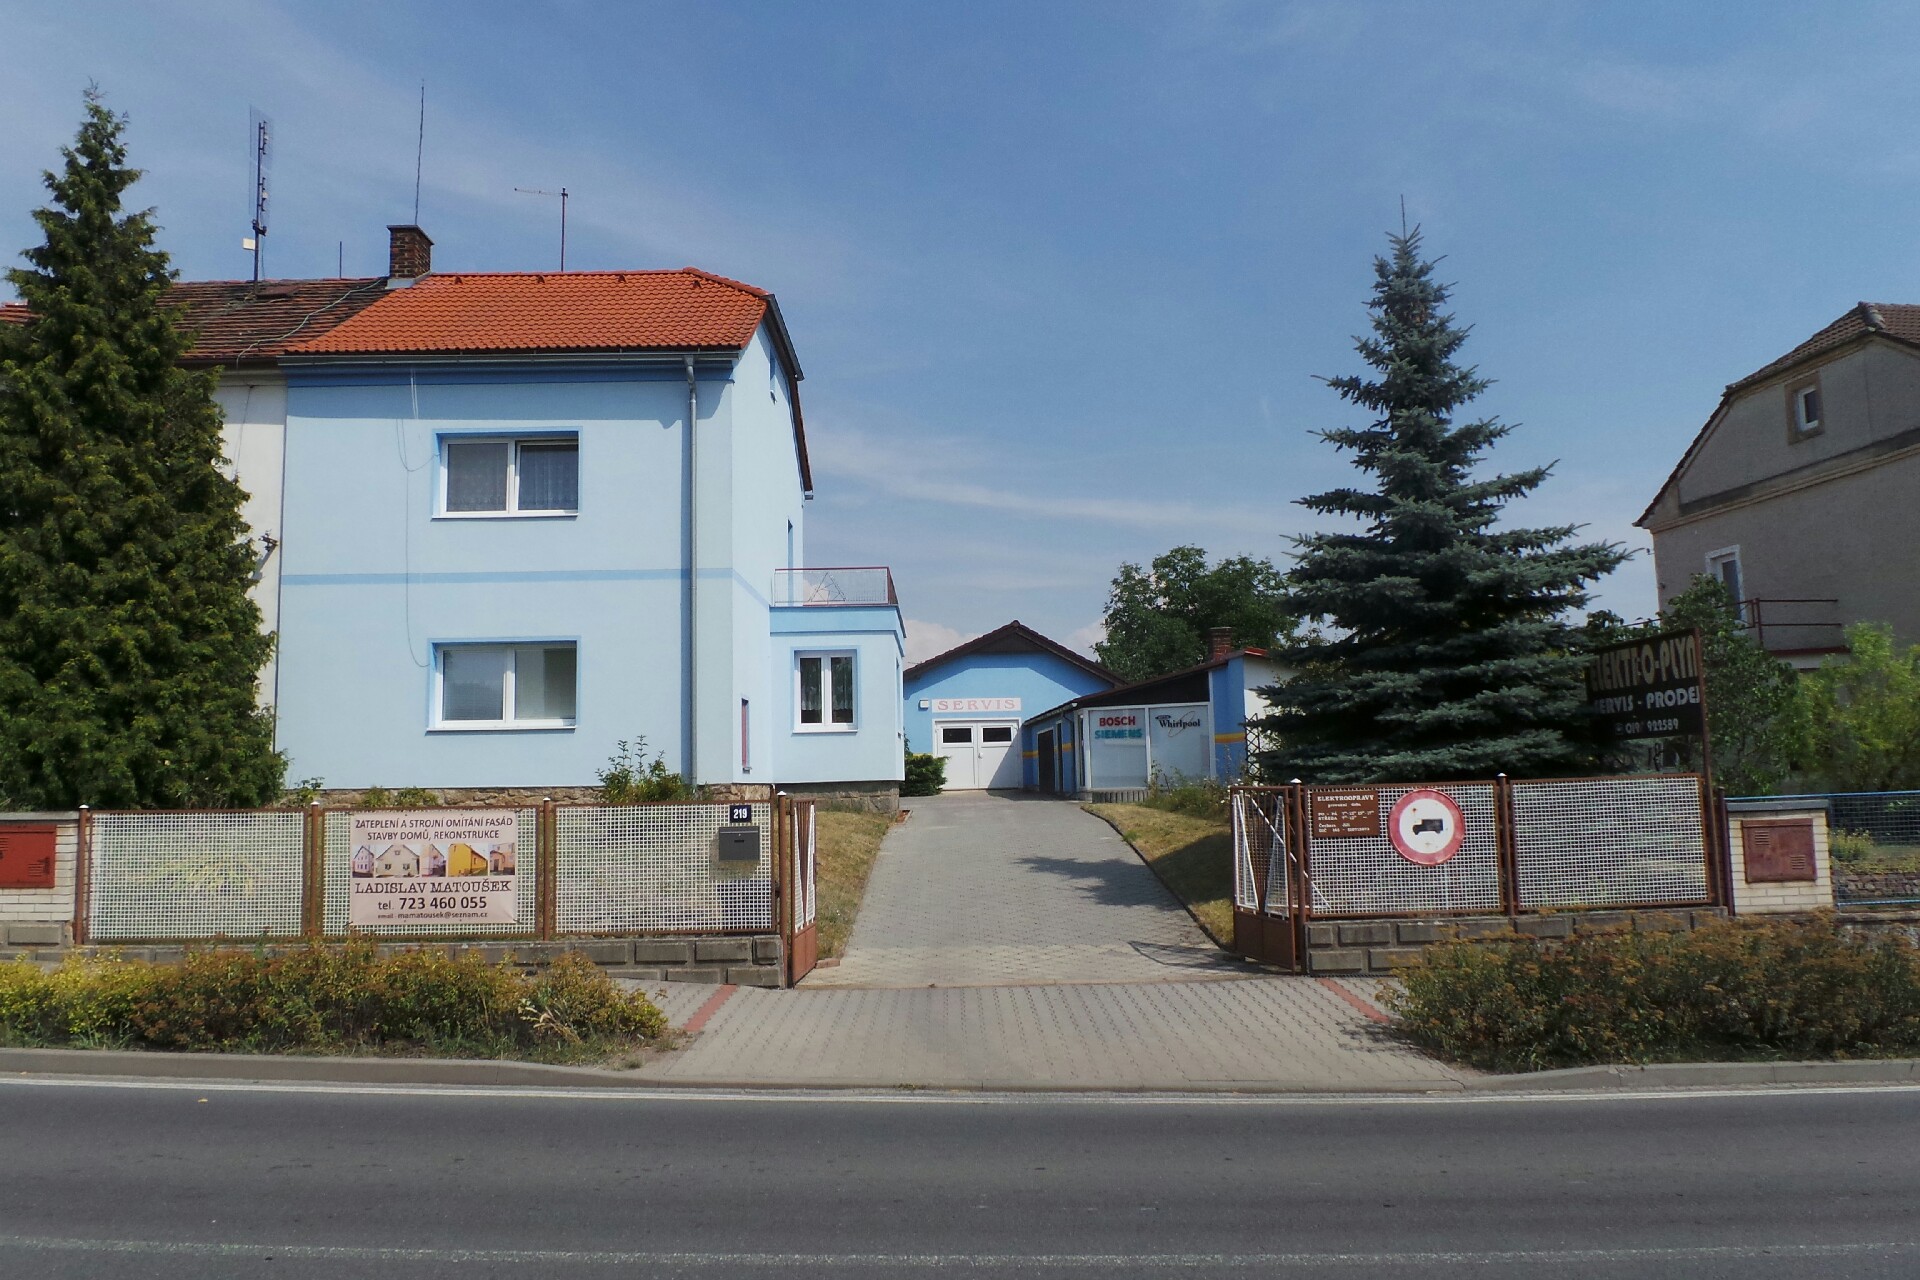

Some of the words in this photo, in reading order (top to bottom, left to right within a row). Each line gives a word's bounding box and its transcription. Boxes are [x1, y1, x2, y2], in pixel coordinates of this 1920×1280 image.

[1645, 685, 1700, 709] PRODEJ
[937, 699, 1016, 711] SERVIS
[1099, 715, 1136, 727] BOSCH
[1158, 718, 1201, 730] Whirlpool
[1094, 728, 1143, 739] SIEMENS
[733, 808, 748, 819] 219
[355, 817, 400, 829] ZATEPLENÍ
[401, 819, 407, 828] A
[409, 817, 445, 828] STROJNÍ
[446, 816, 484, 828] OMÍTÁNÍ
[485, 816, 513, 826] FASÁD
[367, 832, 398, 841] STAVBY
[400, 829, 431, 841] DOMŮ,
[434, 829, 500, 840] REKONSTRUKCE
[355, 882, 427, 894] LADISLAV
[430, 878, 512, 893] MATOUŠEK
[400, 897, 426, 910] 723
[430, 897, 456, 909] 460
[460, 896, 487, 909] 055
[397, 911, 488, 919] mamatousek@seznam.cz
